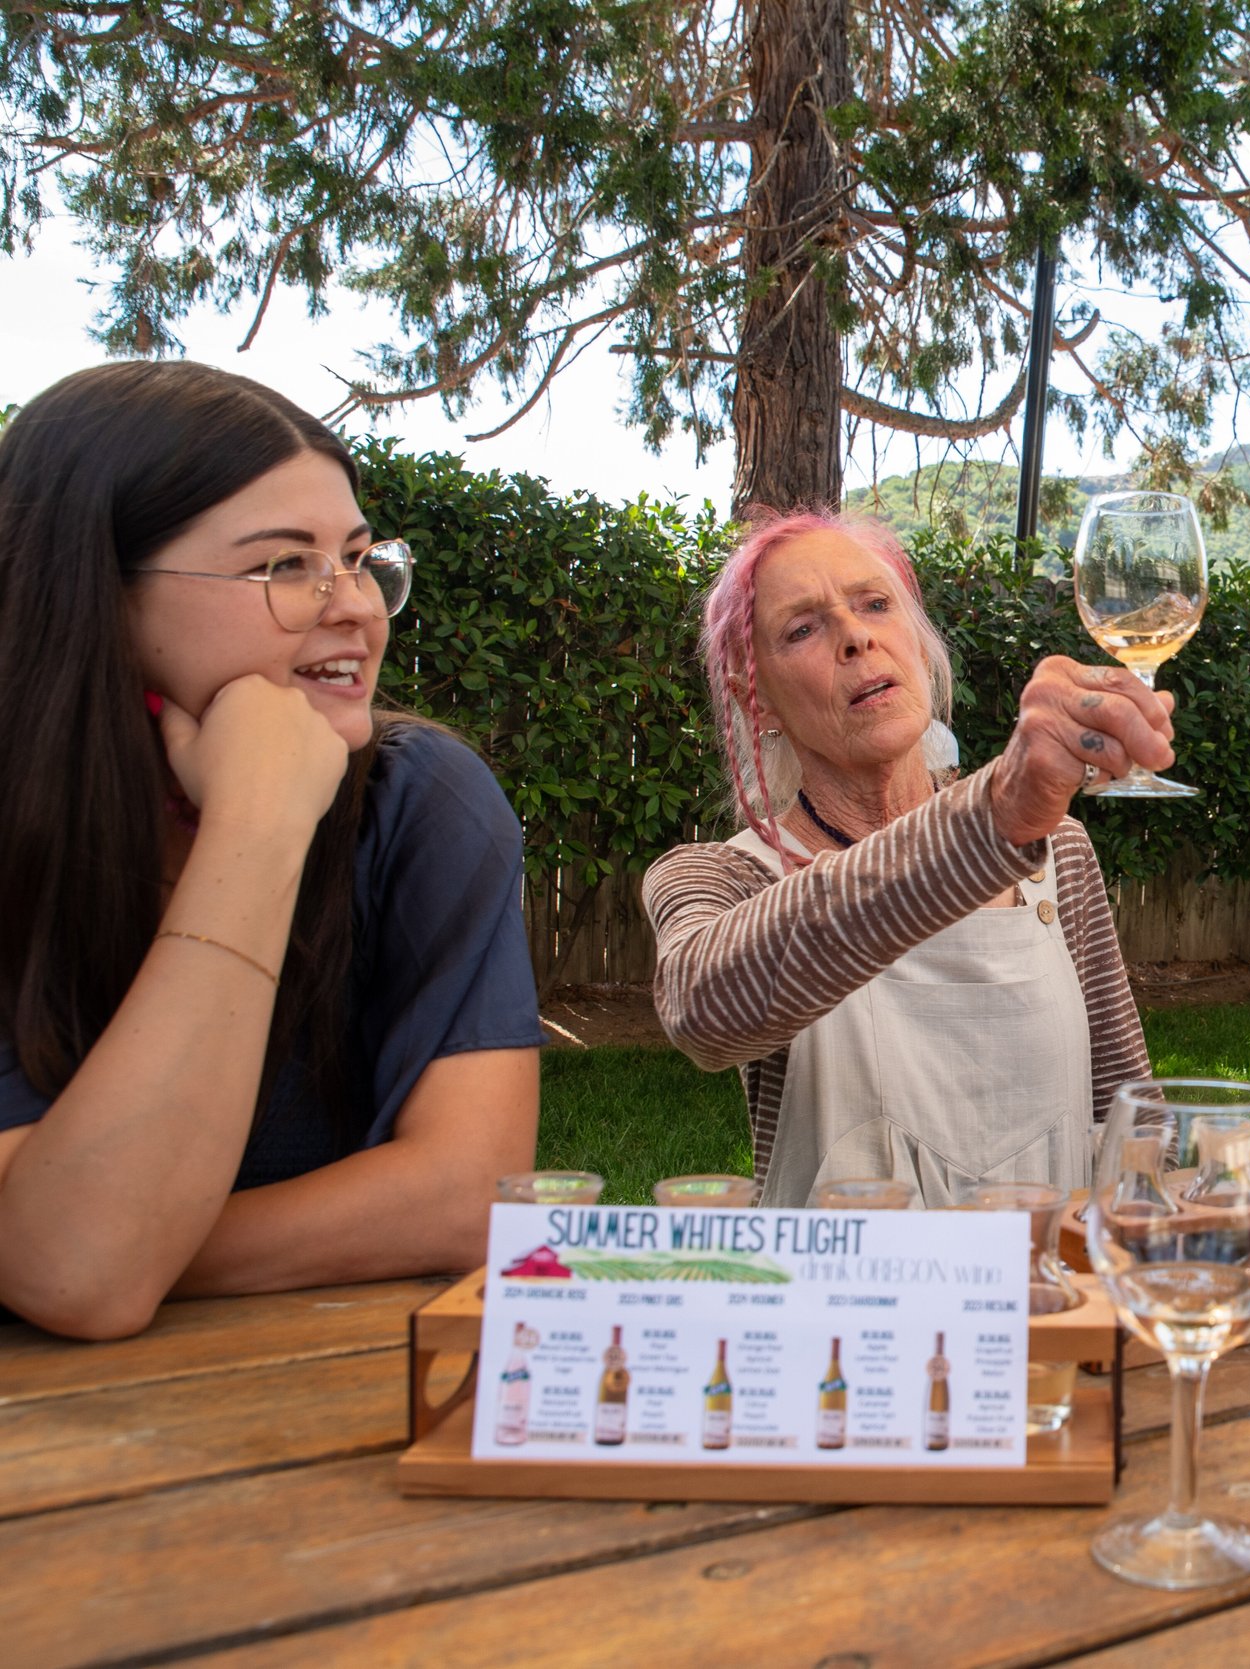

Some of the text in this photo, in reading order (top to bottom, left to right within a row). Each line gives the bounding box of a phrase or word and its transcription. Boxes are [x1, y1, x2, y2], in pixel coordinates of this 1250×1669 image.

[547, 1209, 868, 1255] SUMMER WHITES FLIGHT
[856, 1256, 949, 1284] OREGON
